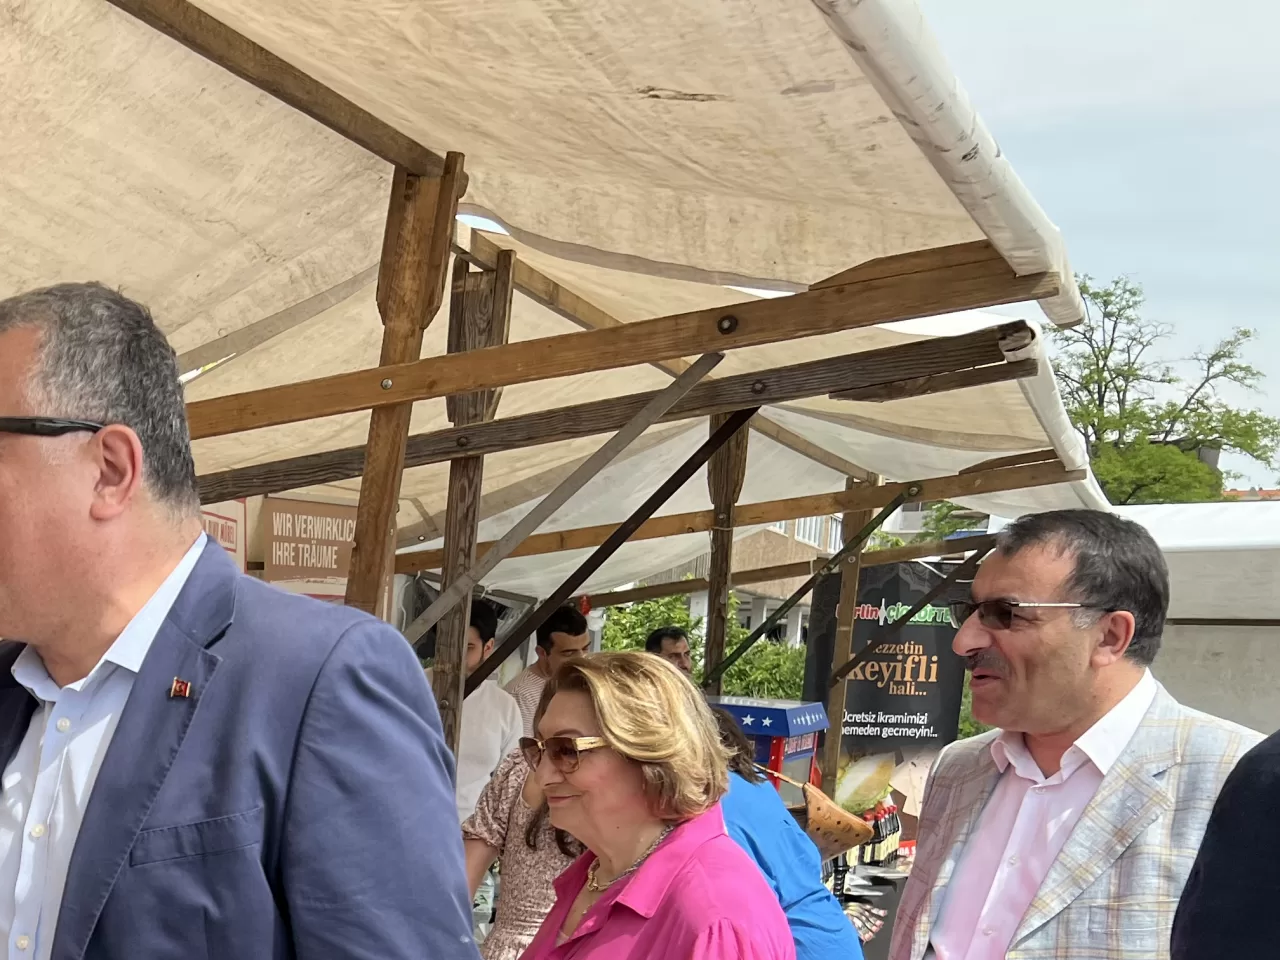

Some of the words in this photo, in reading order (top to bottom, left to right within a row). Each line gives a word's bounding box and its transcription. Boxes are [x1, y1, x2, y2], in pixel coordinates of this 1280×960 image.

[272, 512, 293, 536] WIR
[295, 514, 357, 542] VERWIRKLIC
[272, 542, 297, 566] IHRE
[298, 541, 338, 568] TRÄUME
[873, 641, 923, 655] ezzetin
[847, 654, 938, 688] keyifli
[889, 682, 927, 696] hali...
